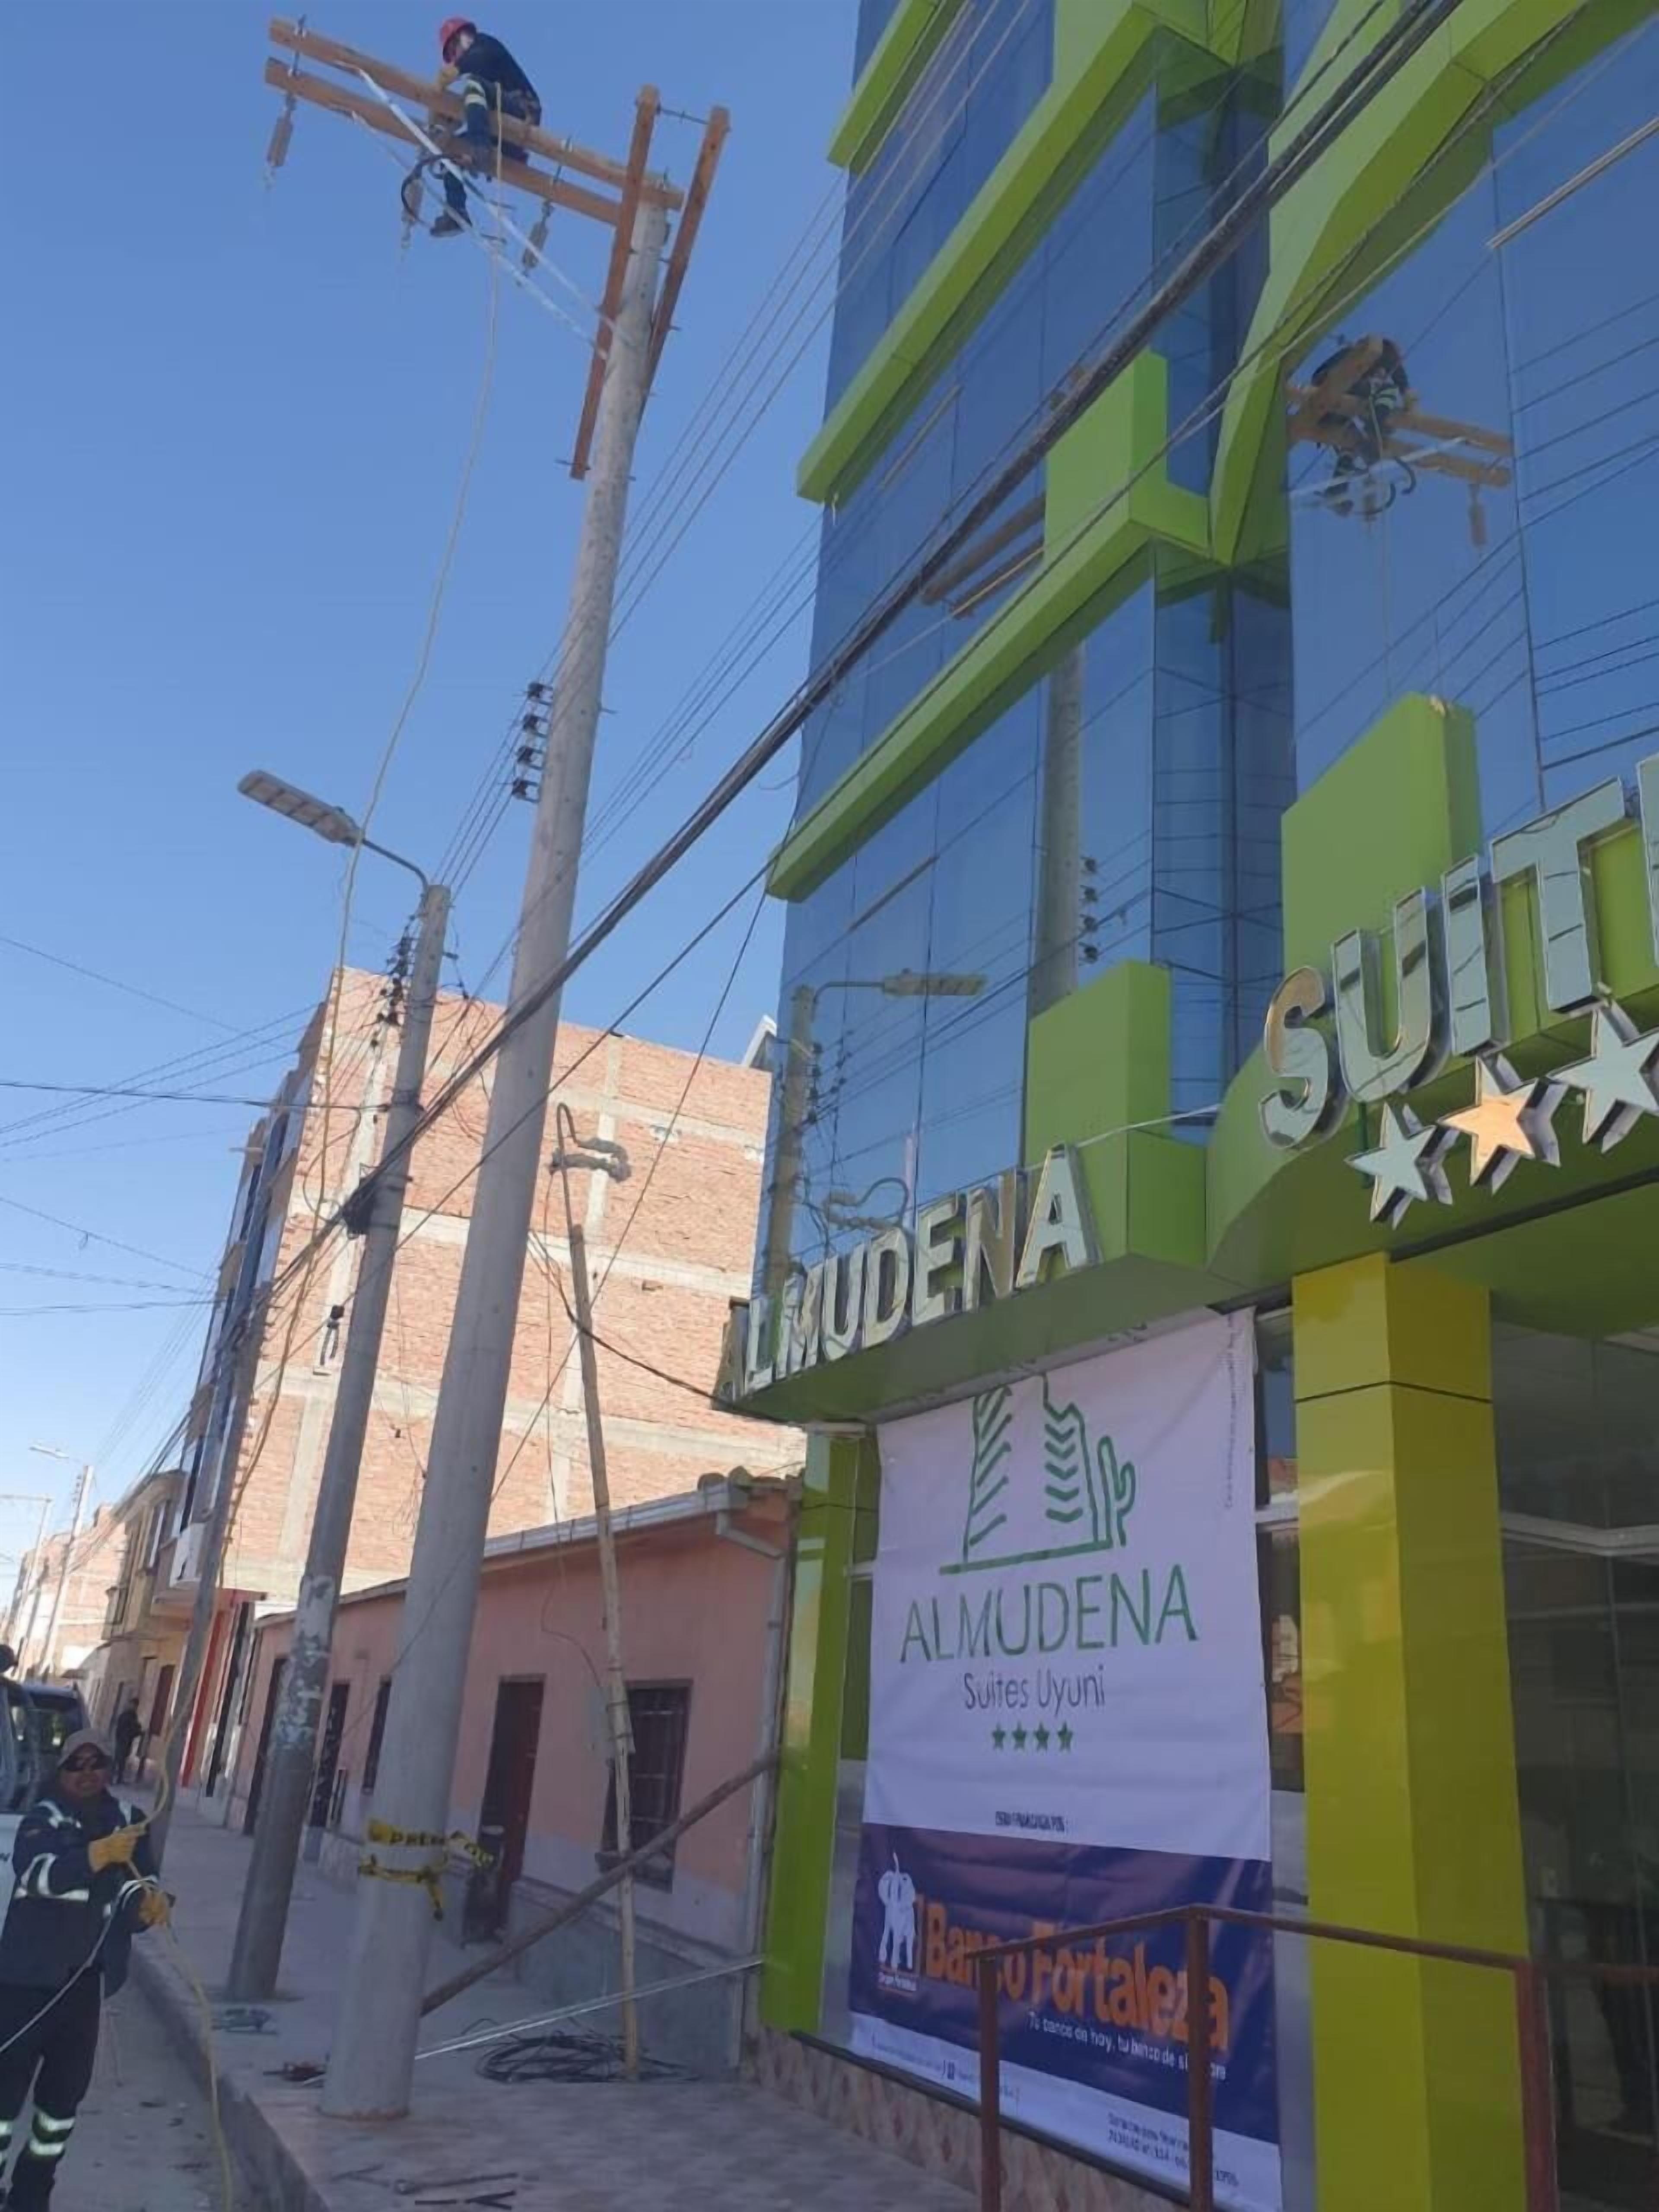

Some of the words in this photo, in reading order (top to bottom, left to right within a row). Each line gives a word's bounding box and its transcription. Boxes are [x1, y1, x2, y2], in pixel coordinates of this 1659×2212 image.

[899, 1564, 1198, 1663] ALMUDENA
[963, 1672, 1028, 1710] Suites
[1038, 1664, 1106, 1718] Uyuni
